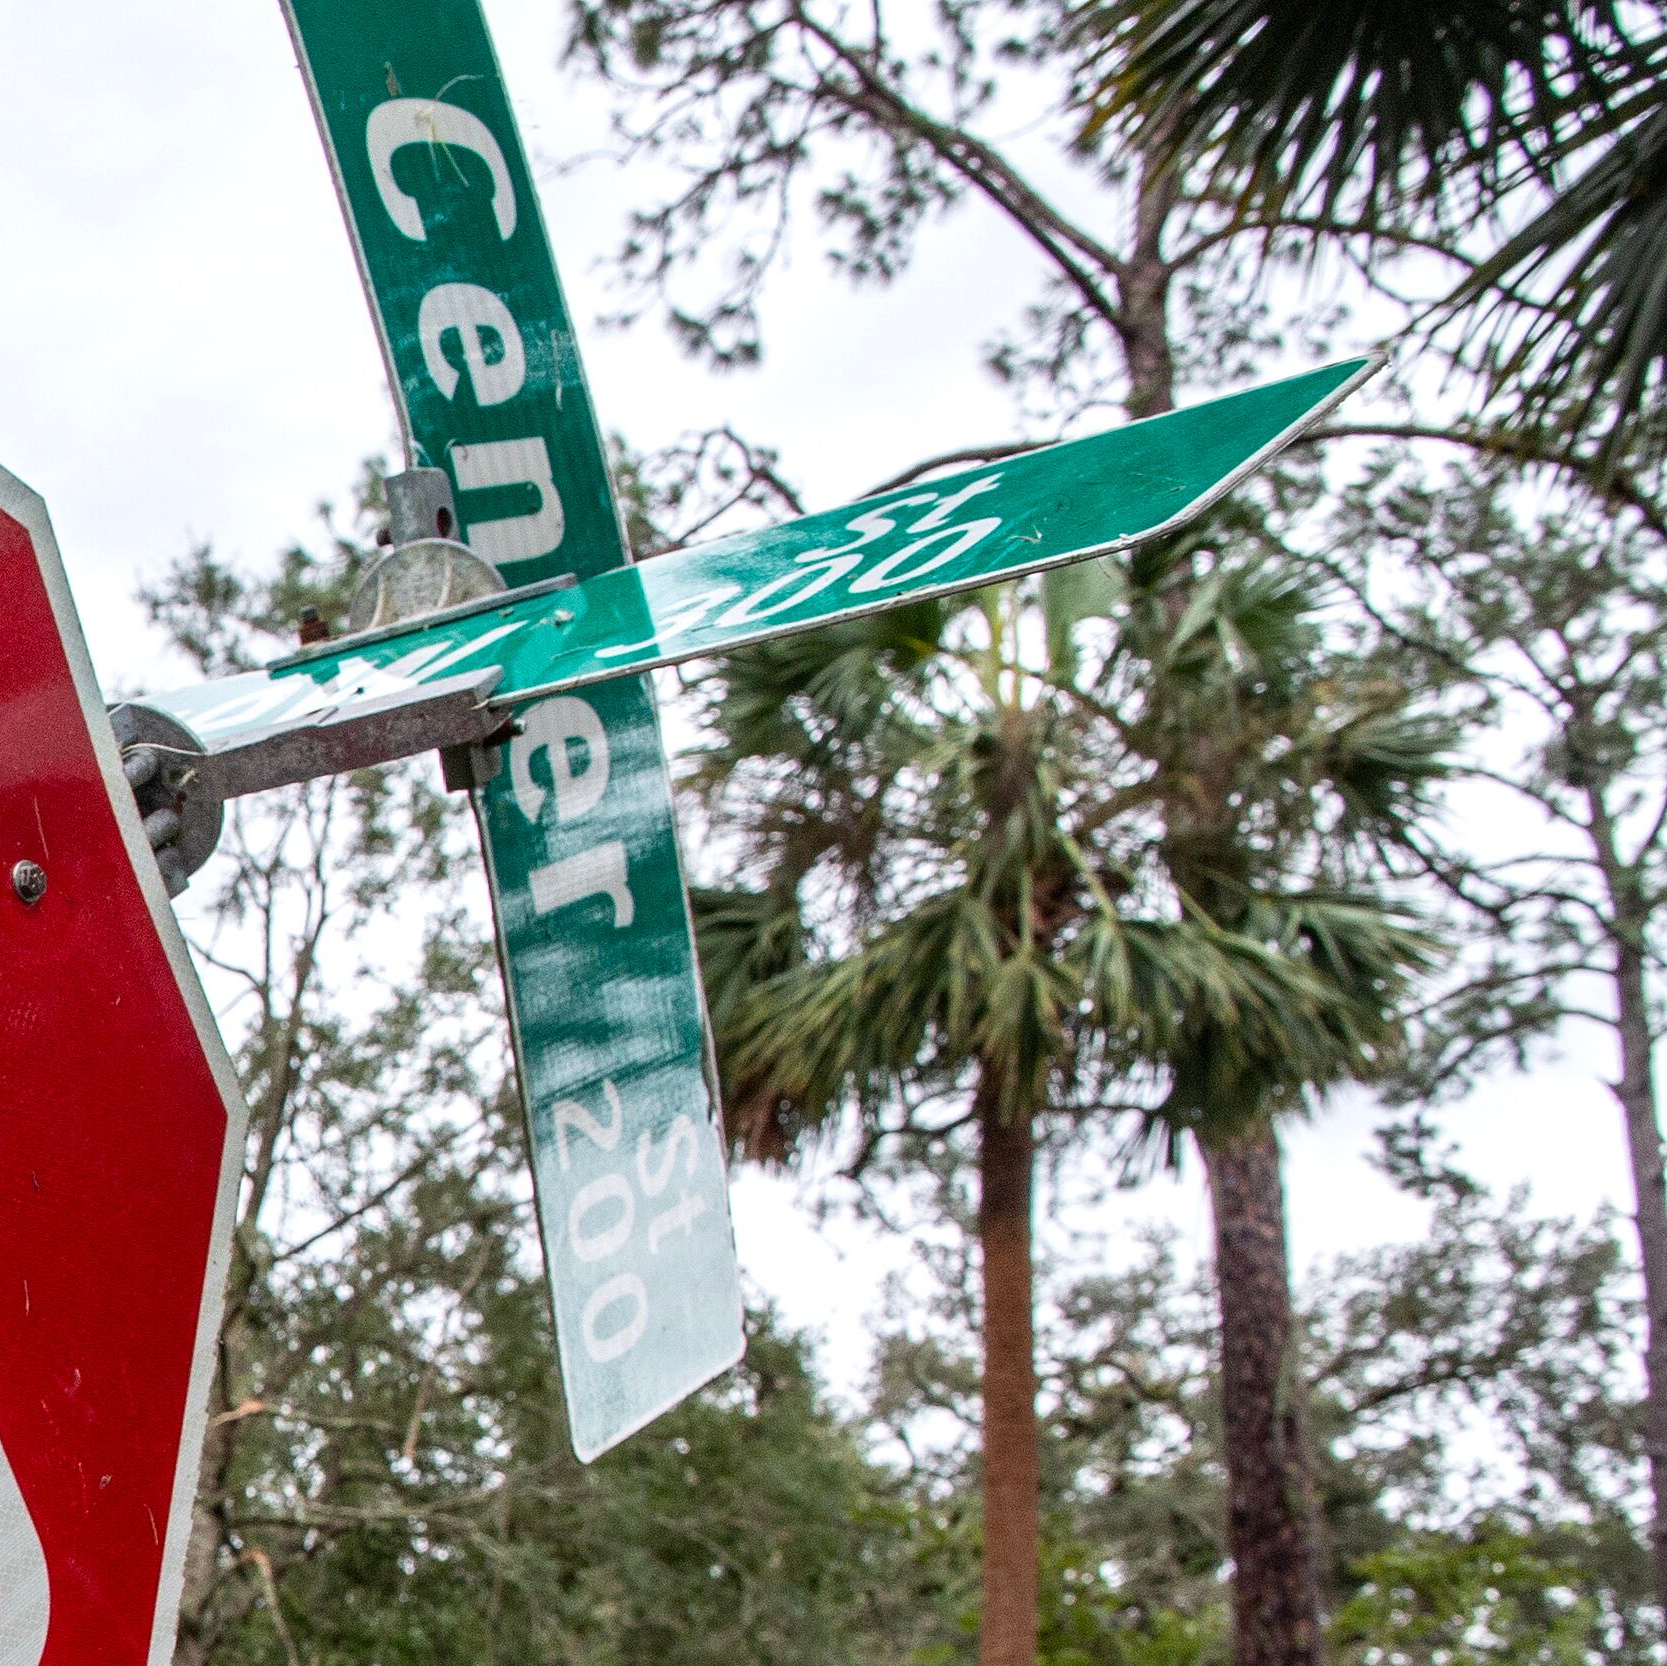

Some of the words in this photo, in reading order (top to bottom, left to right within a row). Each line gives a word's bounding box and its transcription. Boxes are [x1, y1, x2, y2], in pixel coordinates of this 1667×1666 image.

[594, 516, 1002, 659] 300
[795, 471, 1005, 564] St
[365, 97, 635, 929] Cener
[635, 1112, 706, 1256] St
[552, 1080, 650, 1364] 200
